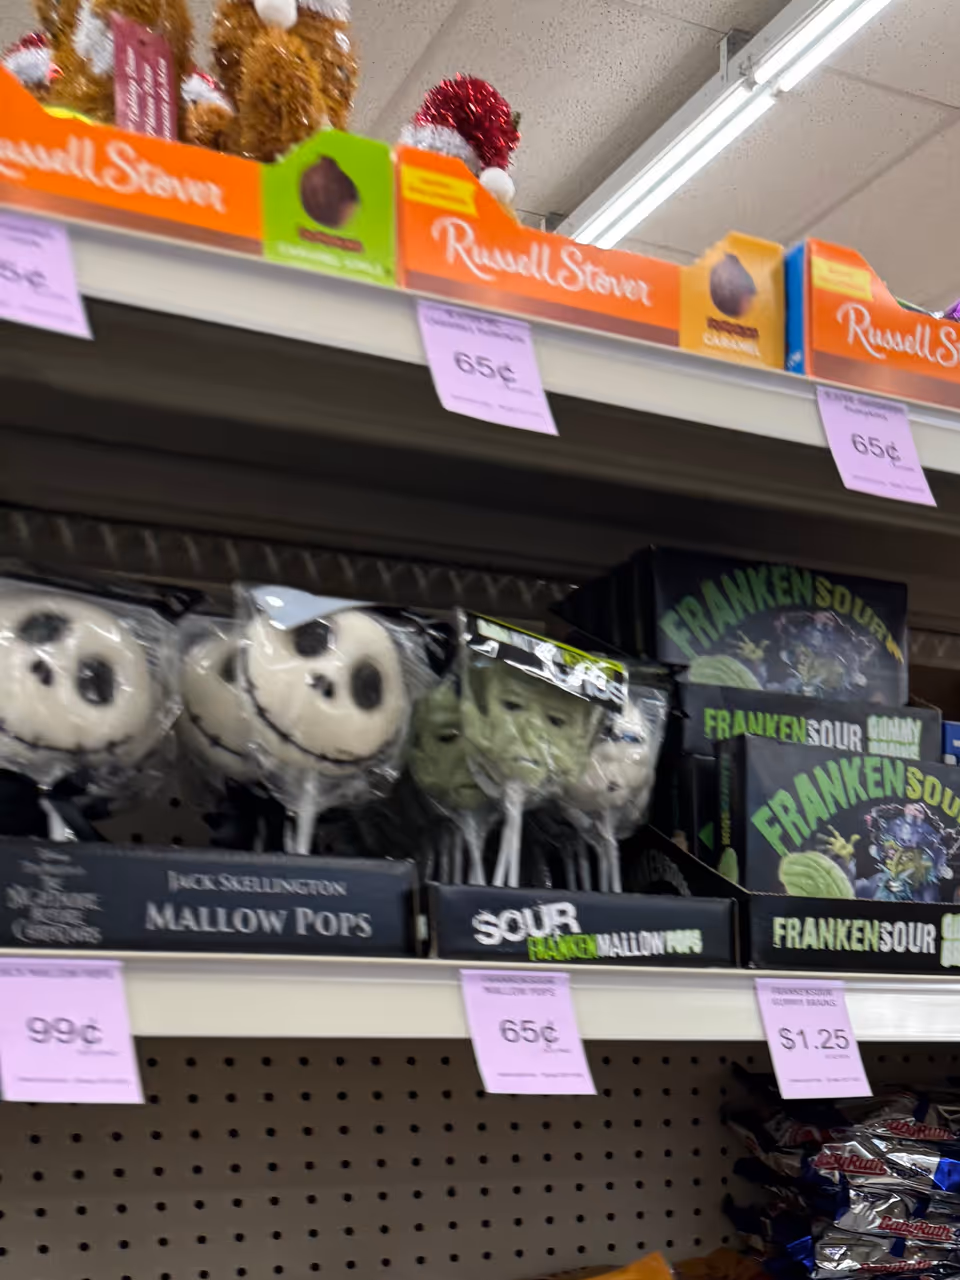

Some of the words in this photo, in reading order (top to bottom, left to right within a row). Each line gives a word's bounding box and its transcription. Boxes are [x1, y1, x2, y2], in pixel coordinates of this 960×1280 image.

[0, 134, 105, 189] ussell
[103, 140, 227, 213] Stover
[431, 217, 560, 289] Russell
[558, 244, 654, 308] Stover
[836, 302, 936, 362] Russell
[454, 352, 518, 384] 65¢
[851, 434, 902, 463] 65¢
[167, 869, 216, 893] JACK
[217, 873, 348, 897] SKELLINGTON
[145, 902, 288, 935] MALLOW
[294, 906, 373, 938] POPS
[472, 902, 582, 946] SOUR
[26, 1015, 104, 1045] 99¢
[499, 1019, 560, 1044] 65¢
[778, 1027, 850, 1051] $1.25
